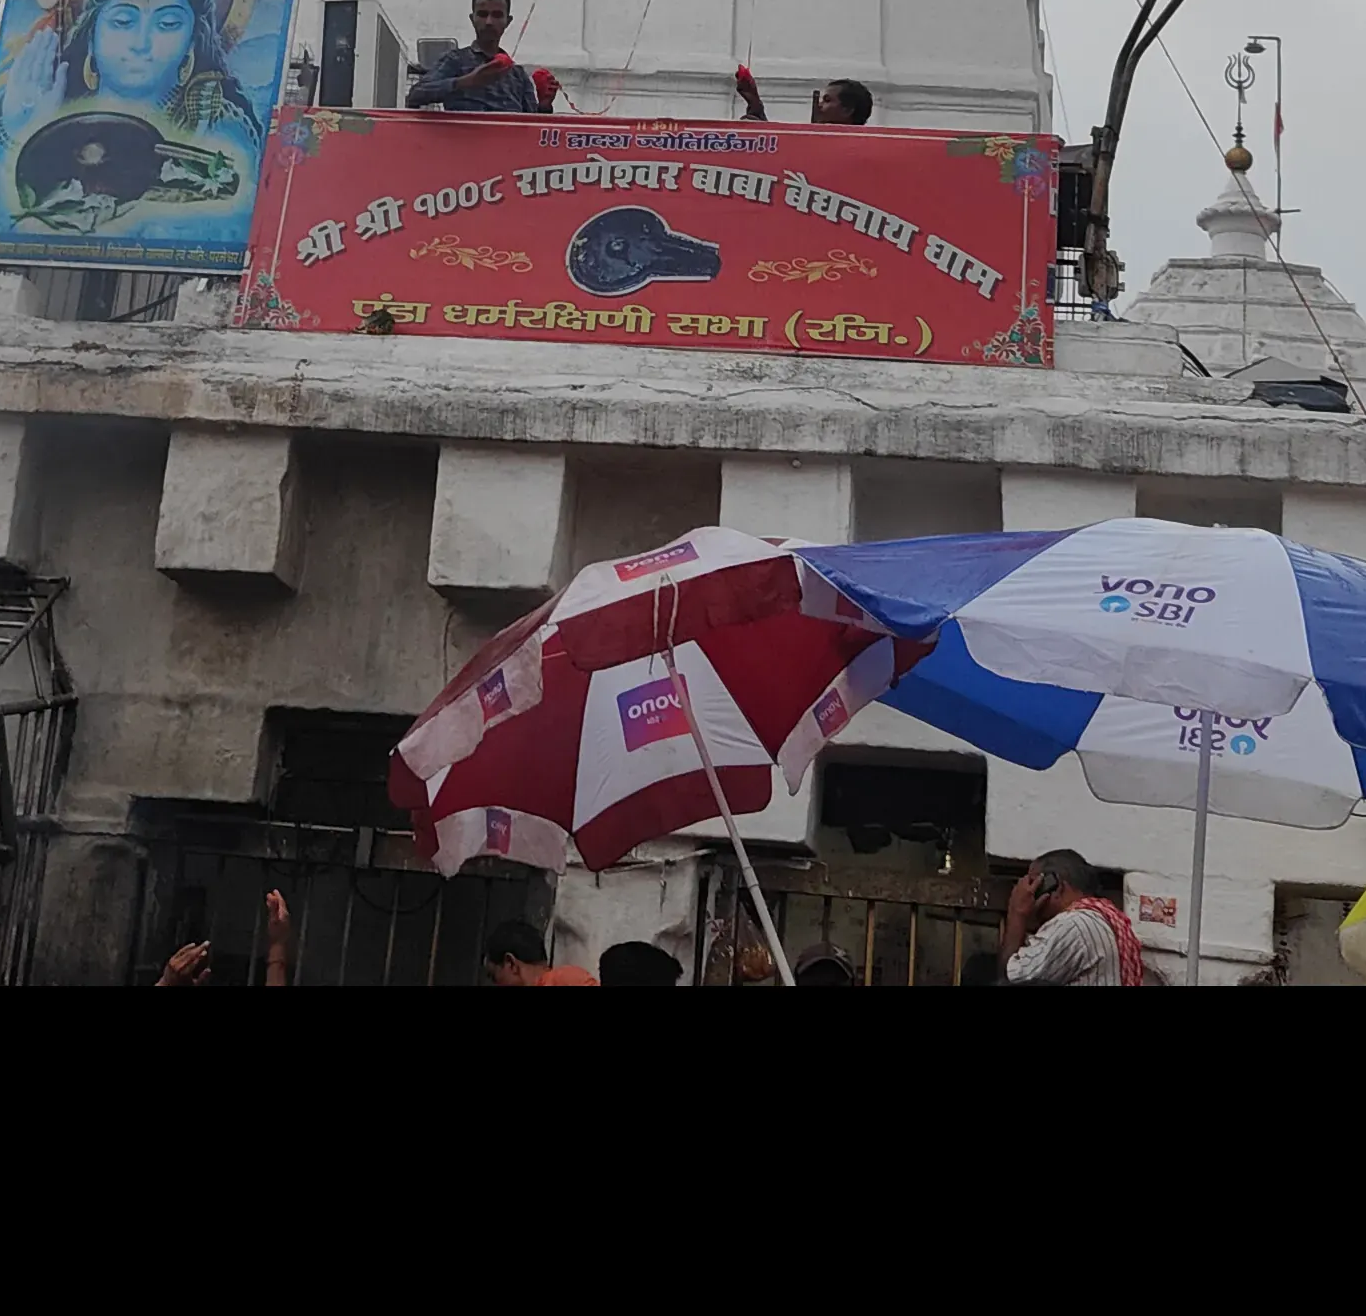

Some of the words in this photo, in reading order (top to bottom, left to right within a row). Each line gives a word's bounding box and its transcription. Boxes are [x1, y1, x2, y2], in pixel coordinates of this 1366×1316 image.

[565, 131, 632, 149] द्वादश
[296, 219, 346, 267] श्री
[355, 196, 404, 241] श्री
[413, 175, 504, 220] १००८
[511, 153, 684, 197] रावणेश्वर
[689, 163, 778, 204] बाबा
[782, 169, 920, 252] बैद्यनाथ
[923, 233, 1004, 300] धाम
[352, 292, 431, 324] पंडा
[442, 298, 656, 334] धर्मरक्षिणी
[667, 313, 768, 339] सभा
[783, 309, 935, 356] (रजि.)
[1093, 575, 1216, 604] yono
[1134, 600, 1196, 624] SBI
